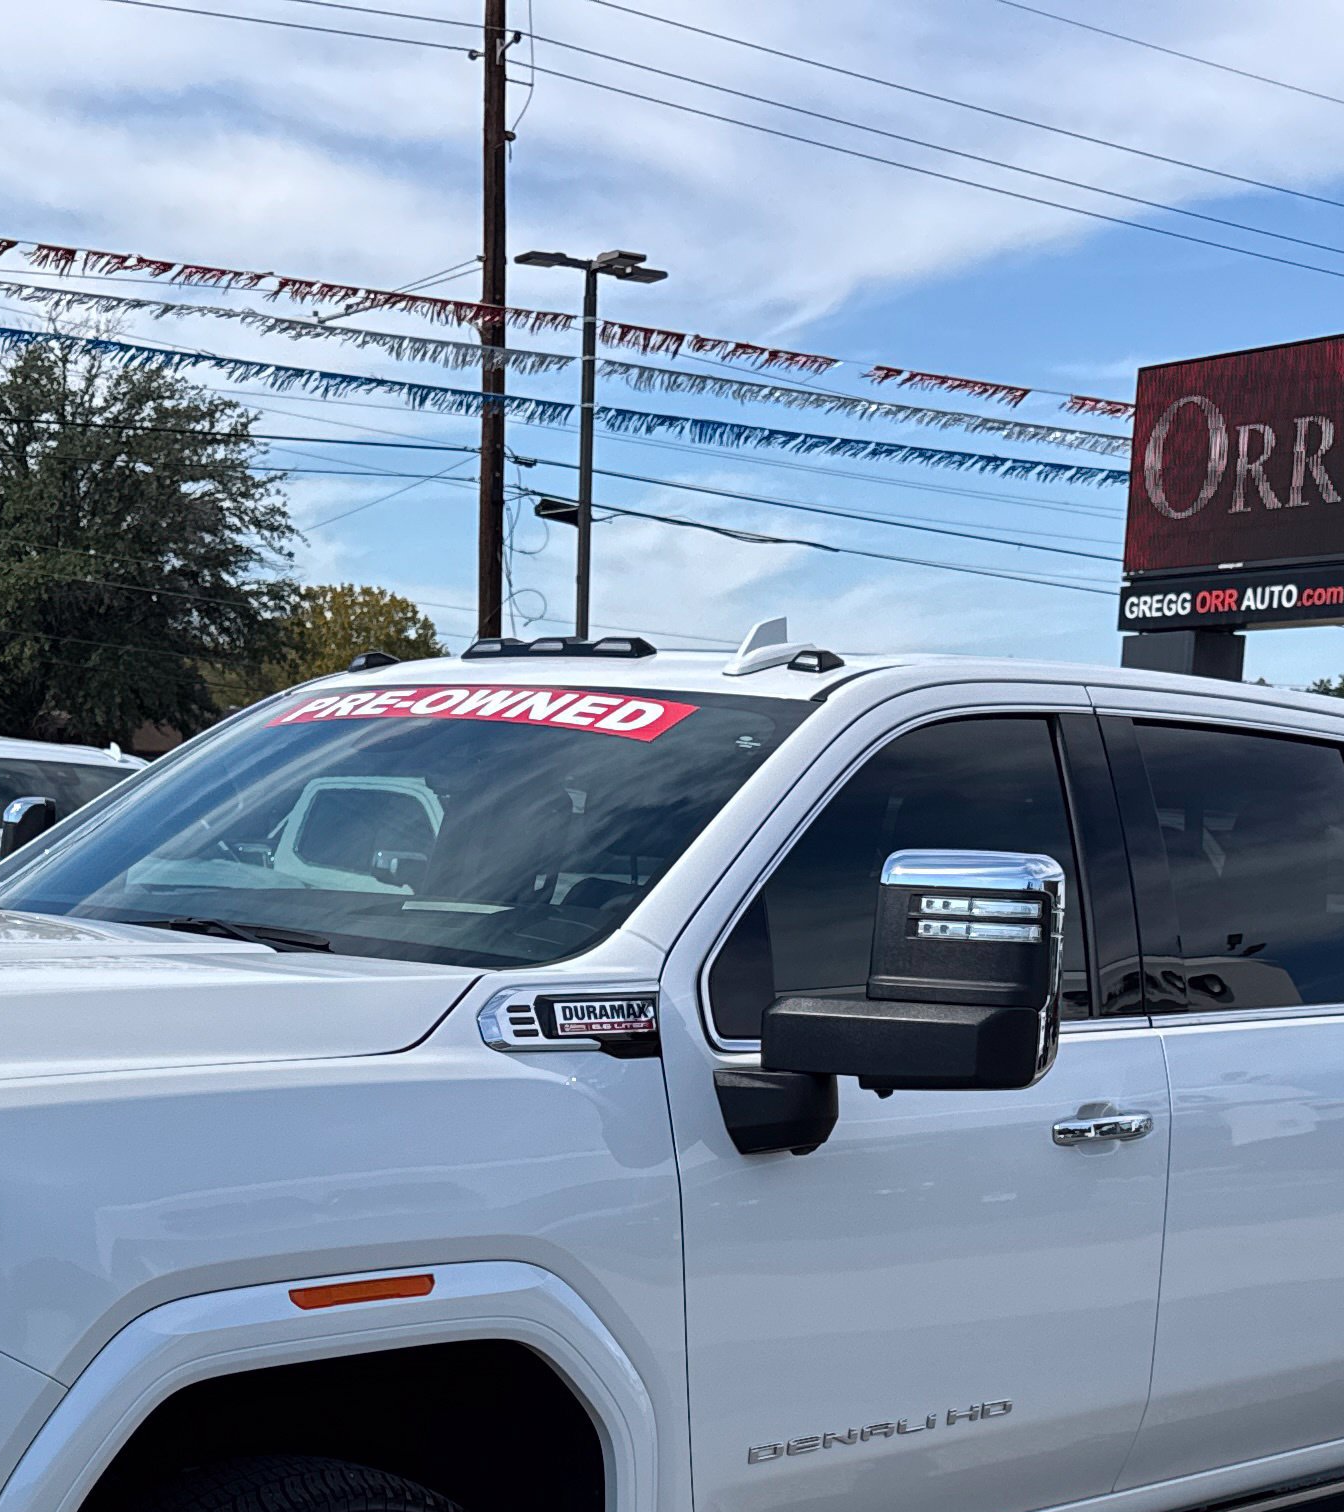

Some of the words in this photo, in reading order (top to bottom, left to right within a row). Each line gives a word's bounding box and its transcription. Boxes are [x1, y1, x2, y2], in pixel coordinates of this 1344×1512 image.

[1124, 592, 1191, 619] GREGG
[1196, 588, 1238, 614] ORR
[1240, 584, 1344, 611] AUTO.com
[281, 689, 665, 732] PRE-OWNED
[561, 1003, 648, 1021] DURAMAX
[748, 1413, 937, 1464] DENALI
[946, 1398, 1013, 1426] HD
